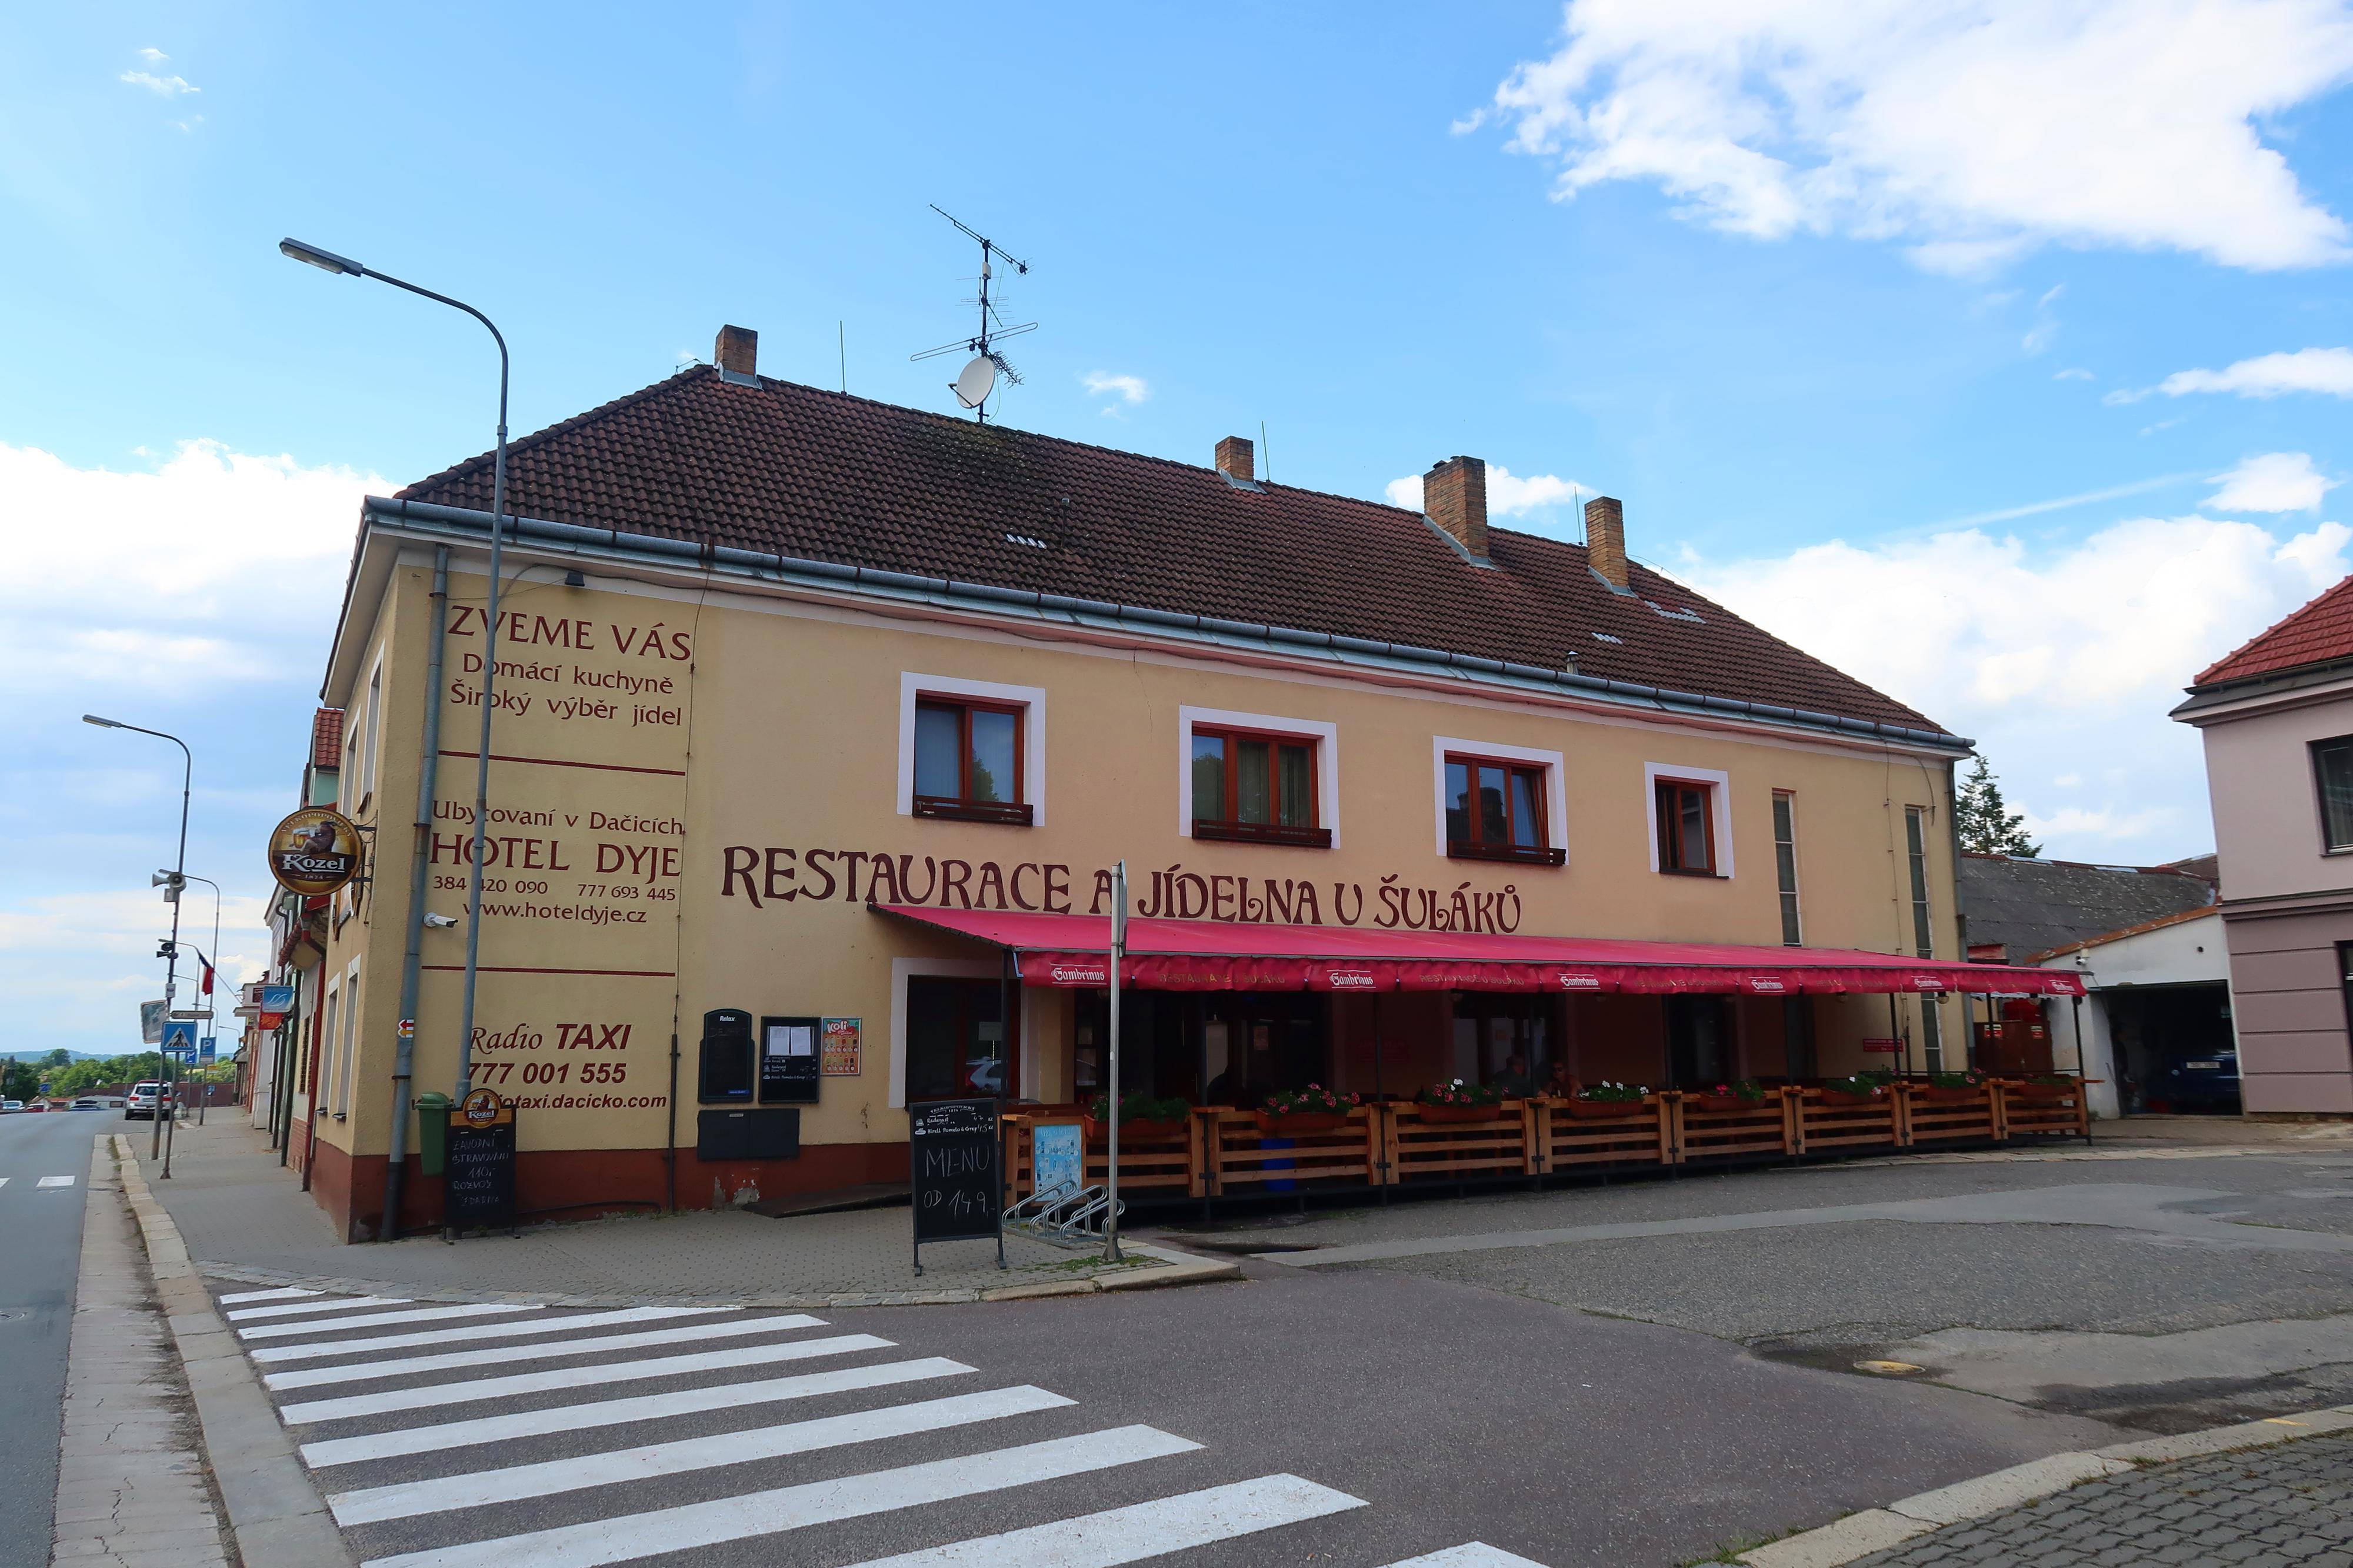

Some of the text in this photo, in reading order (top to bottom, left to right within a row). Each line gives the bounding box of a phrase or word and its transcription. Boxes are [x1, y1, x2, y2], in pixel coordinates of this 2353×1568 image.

[448, 605, 691, 661] ZVEME VÁS
[463, 653, 674, 696] Domácí kuchyně
[450, 678, 682, 728] Široký výběr jídel
[565, 814, 579, 828] v
[589, 811, 685, 835] Dačicích
[282, 854, 345, 872] Kozel
[429, 832, 682, 885] HOTEL DYJE
[434, 876, 467, 890] 384
[515, 880, 548, 894] 090
[578, 884, 676, 901] 777 693 445
[721, 846, 1521, 935] RESTAURACE A JÍDELNA U ŠULÁKŮ
[1051, 967, 1105, 981] Gambrinus
[1329, 972, 1374, 986] Gambrinus
[471, 1023, 632, 1055] Radio TAXI
[468, 1062, 626, 1084] 777 001 555
[468, 1110, 495, 1119] Kozel
[926, 1146, 989, 1177] MENU
[924, 1190, 942, 1208] OD
